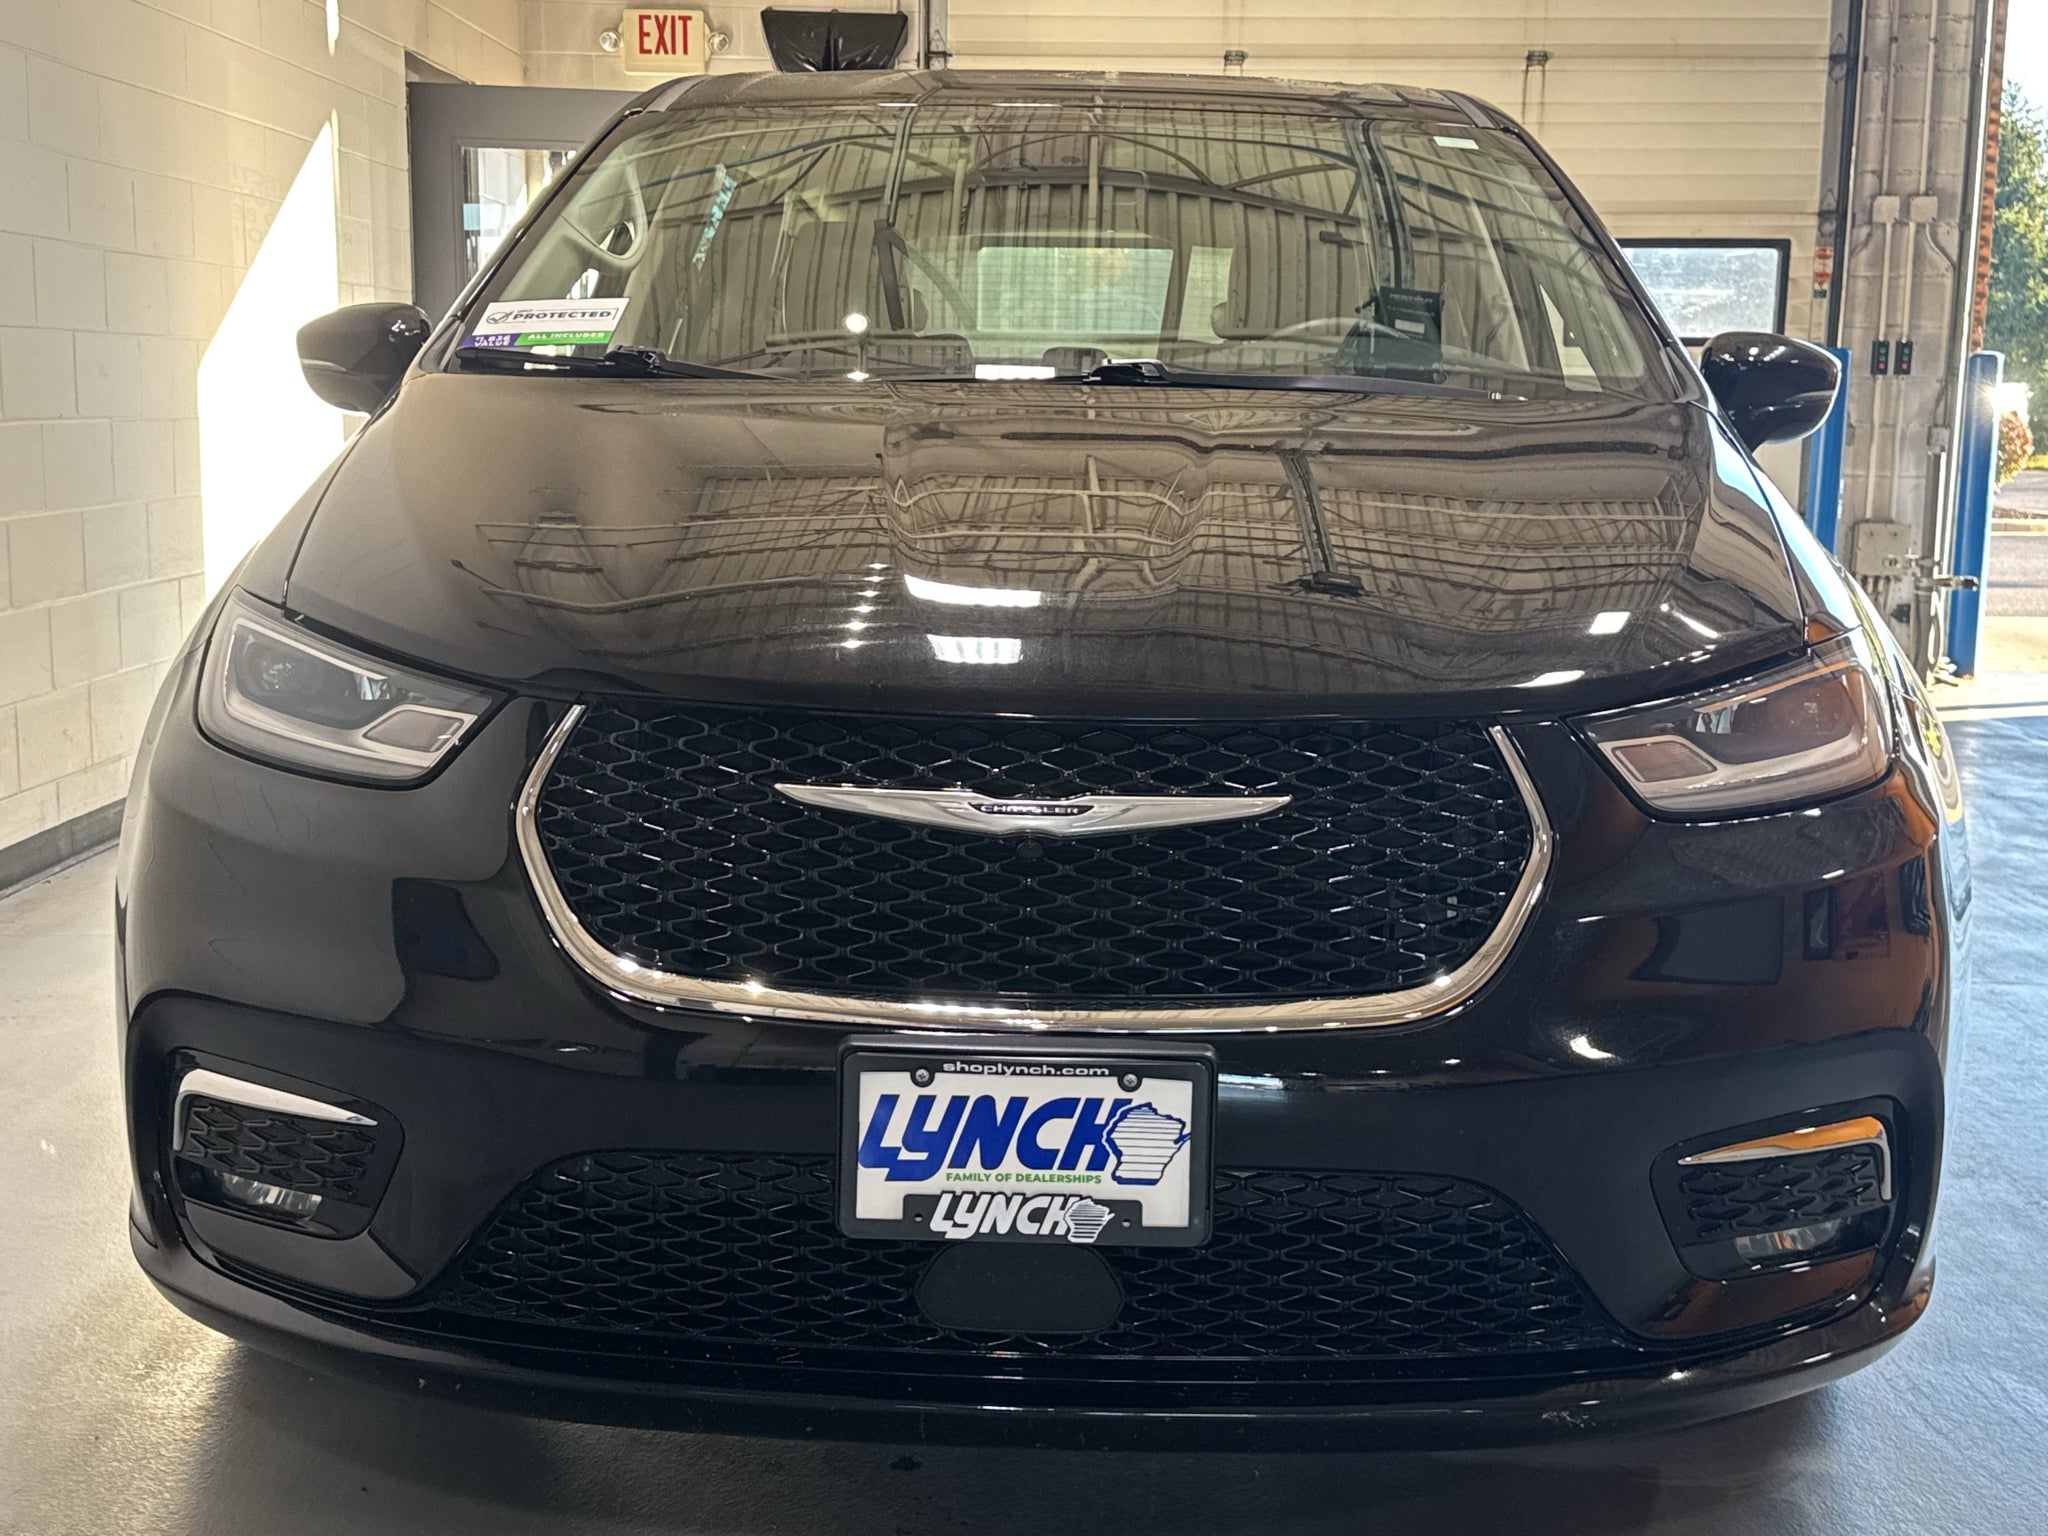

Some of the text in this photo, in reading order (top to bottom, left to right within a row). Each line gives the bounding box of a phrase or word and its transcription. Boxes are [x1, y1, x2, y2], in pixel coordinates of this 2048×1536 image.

[637, 14, 692, 55] EXIT
[512, 311, 612, 320] PROTECTED
[980, 804, 1079, 815] CHRYSLER
[943, 1062, 1109, 1077] shoplynch.com
[858, 1094, 1133, 1182] LYNCH
[946, 1172, 1102, 1184] FAMILY OF DEALERSHIPS
[929, 1191, 1082, 1239] LYNCH
